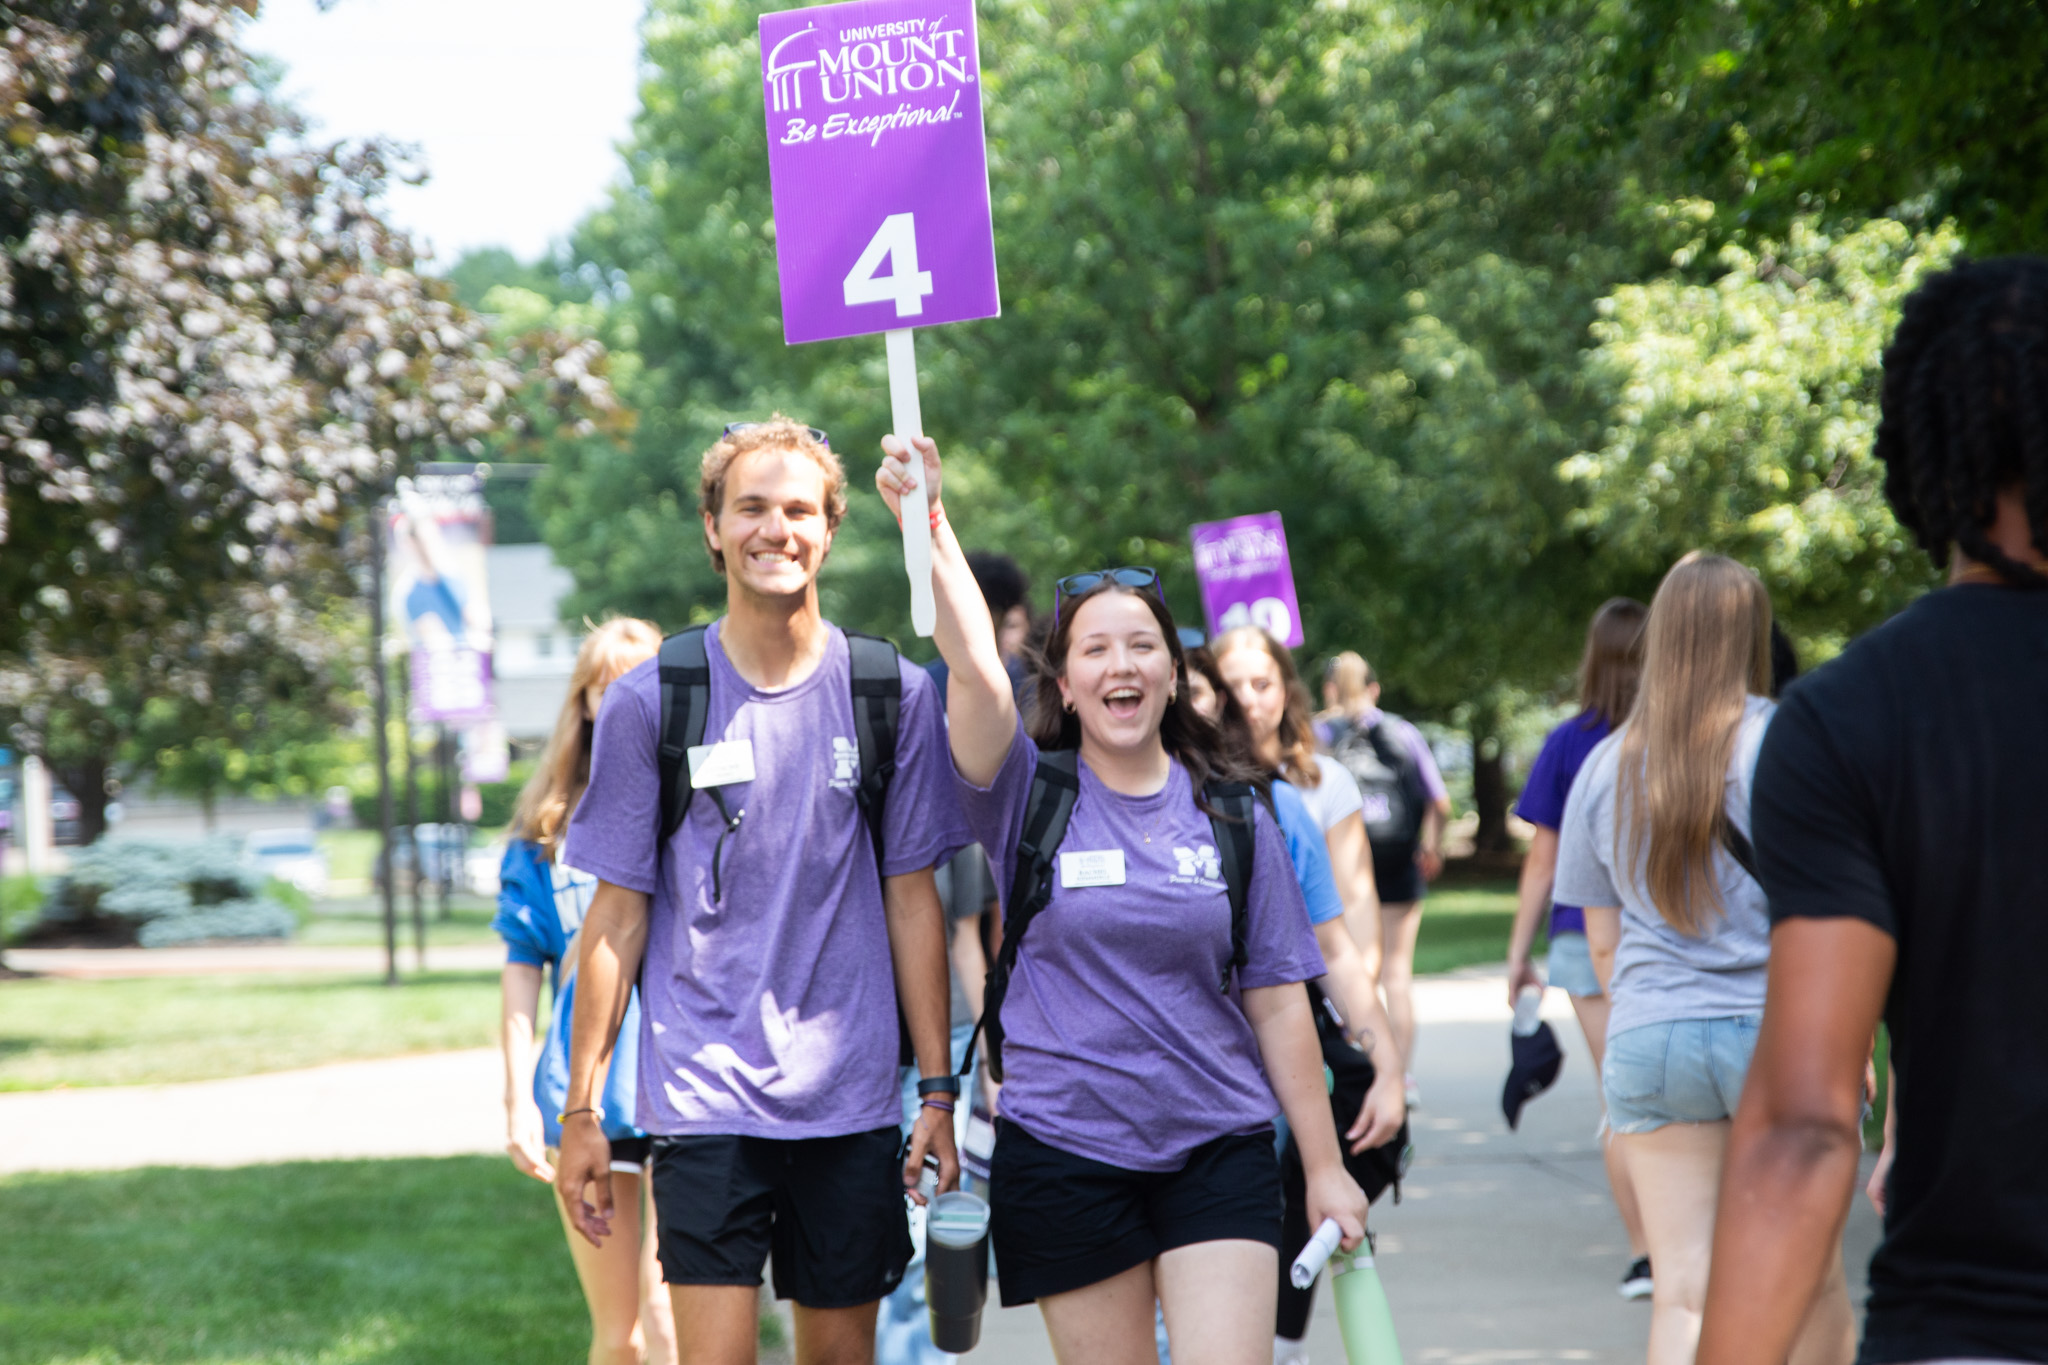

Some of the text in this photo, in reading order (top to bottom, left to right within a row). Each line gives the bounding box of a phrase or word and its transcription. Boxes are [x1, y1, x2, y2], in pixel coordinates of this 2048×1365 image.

[839, 14, 948, 43] UNIVERSITY of
[818, 29, 964, 76] MOUNT
[780, 118, 818, 145] Be
[843, 212, 933, 318] 4
